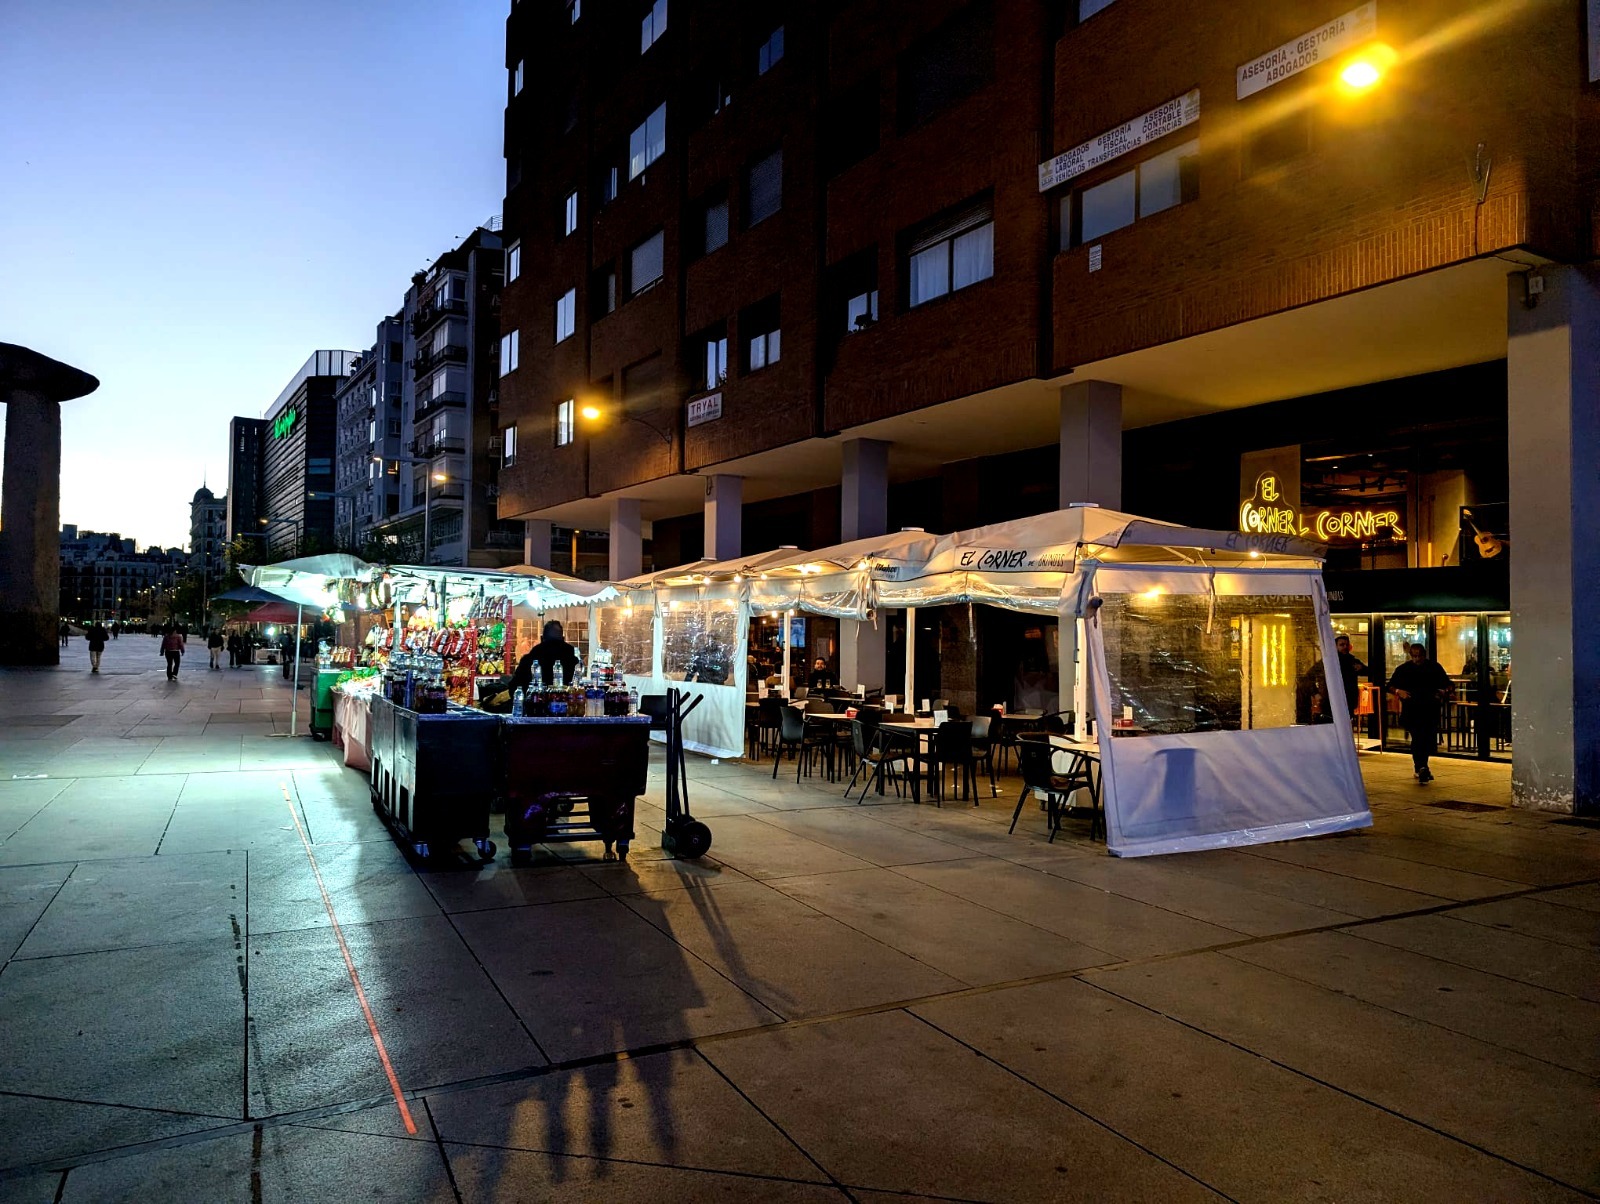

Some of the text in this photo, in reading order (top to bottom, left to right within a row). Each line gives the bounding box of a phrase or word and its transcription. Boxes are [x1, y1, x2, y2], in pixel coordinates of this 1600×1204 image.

[1241, 49, 1287, 81] ASESORÍA
[1297, 21, 1346, 53] GESTORÍA
[1266, 48, 1319, 84] ABOGADOS
[1054, 143, 1090, 165] ABOGADOS
[1097, 123, 1132, 146] GESTORÍA
[1143, 99, 1182, 123] ASESORÍA
[1055, 156, 1084, 174] LABORAL
[1103, 136, 1128, 151] FISCAL
[1142, 108, 1182, 134] CONTABLE
[1087, 137, 1142, 167] TRANSFERENCIAS
[1145, 117, 1182, 141] HERENCIAS
[691, 397, 719, 415] TRYAL
[1261, 476, 1279, 502] EL
[1240, 502, 1297, 535] CORNER
[960, 551, 977, 566] EL
[977, 549, 1028, 570] CORNER
